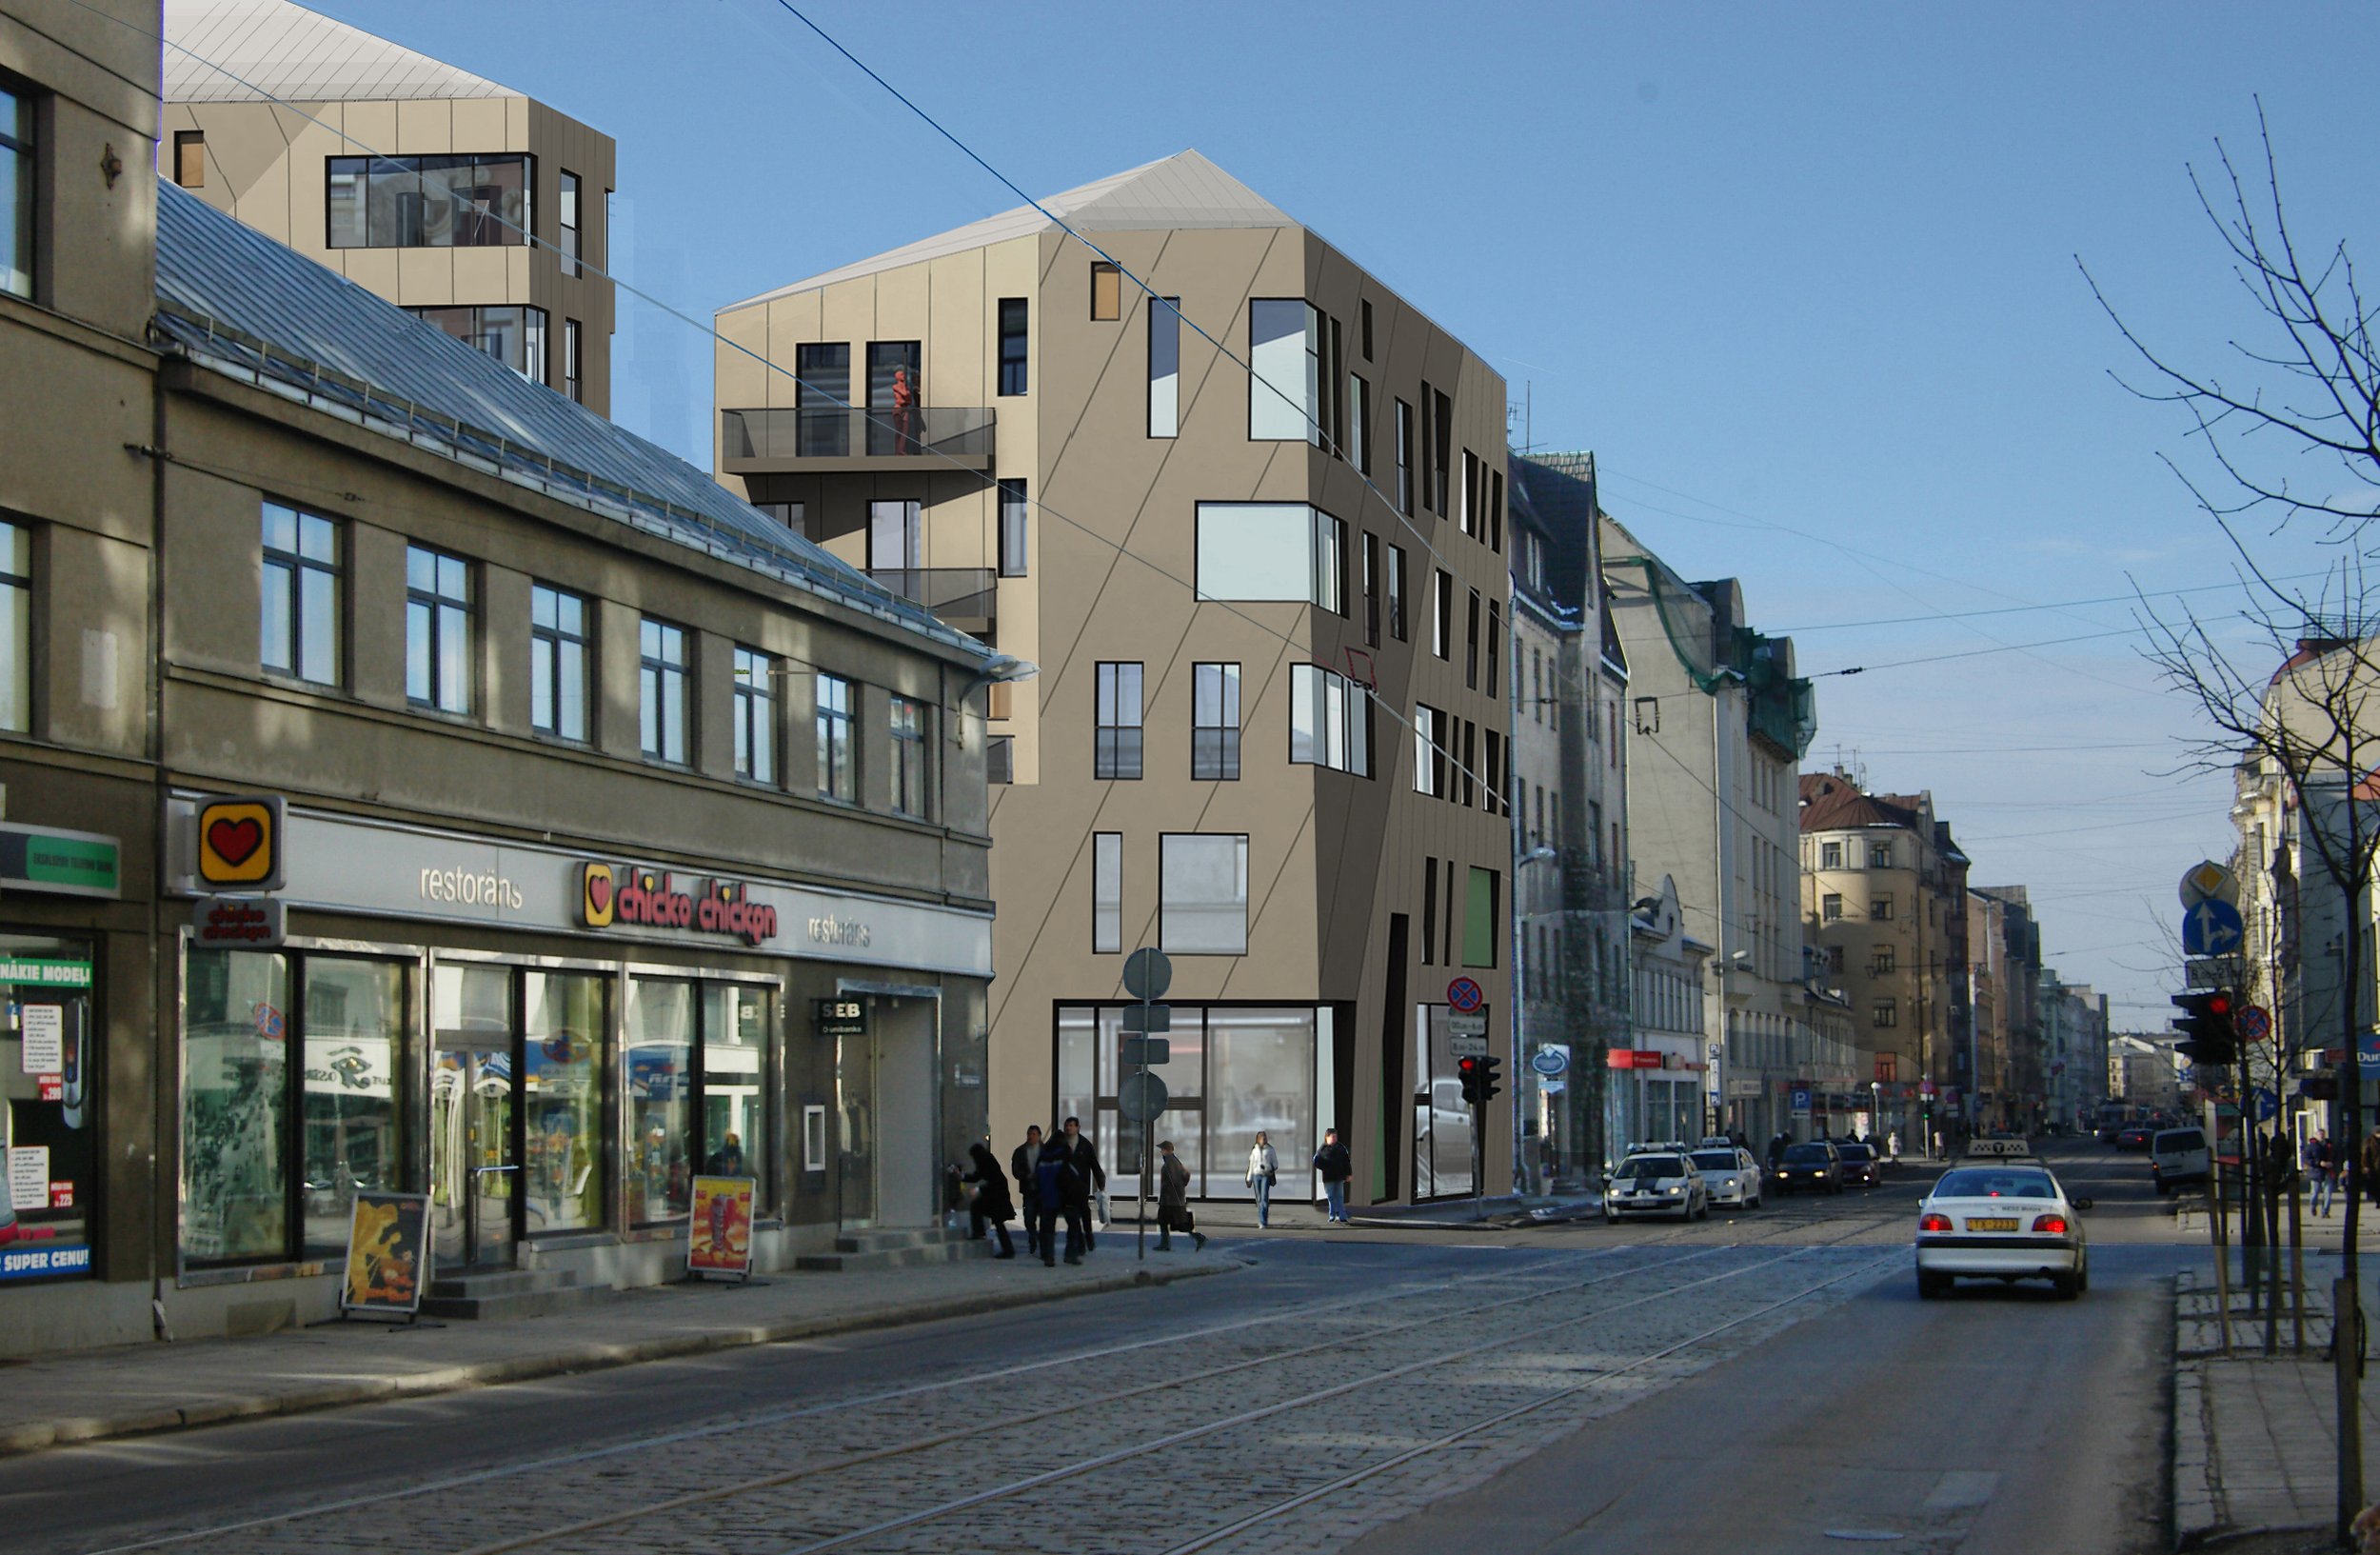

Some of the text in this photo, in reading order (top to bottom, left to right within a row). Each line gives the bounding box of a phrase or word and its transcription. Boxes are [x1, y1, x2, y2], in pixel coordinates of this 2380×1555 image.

[618, 867, 691, 927] chicko
[823, 1003, 861, 1018] SEB
[1795, 1092, 1806, 1106] P
[4, 1252, 49, 1272] SUPER
[51, 1248, 89, 1268] CENU!
